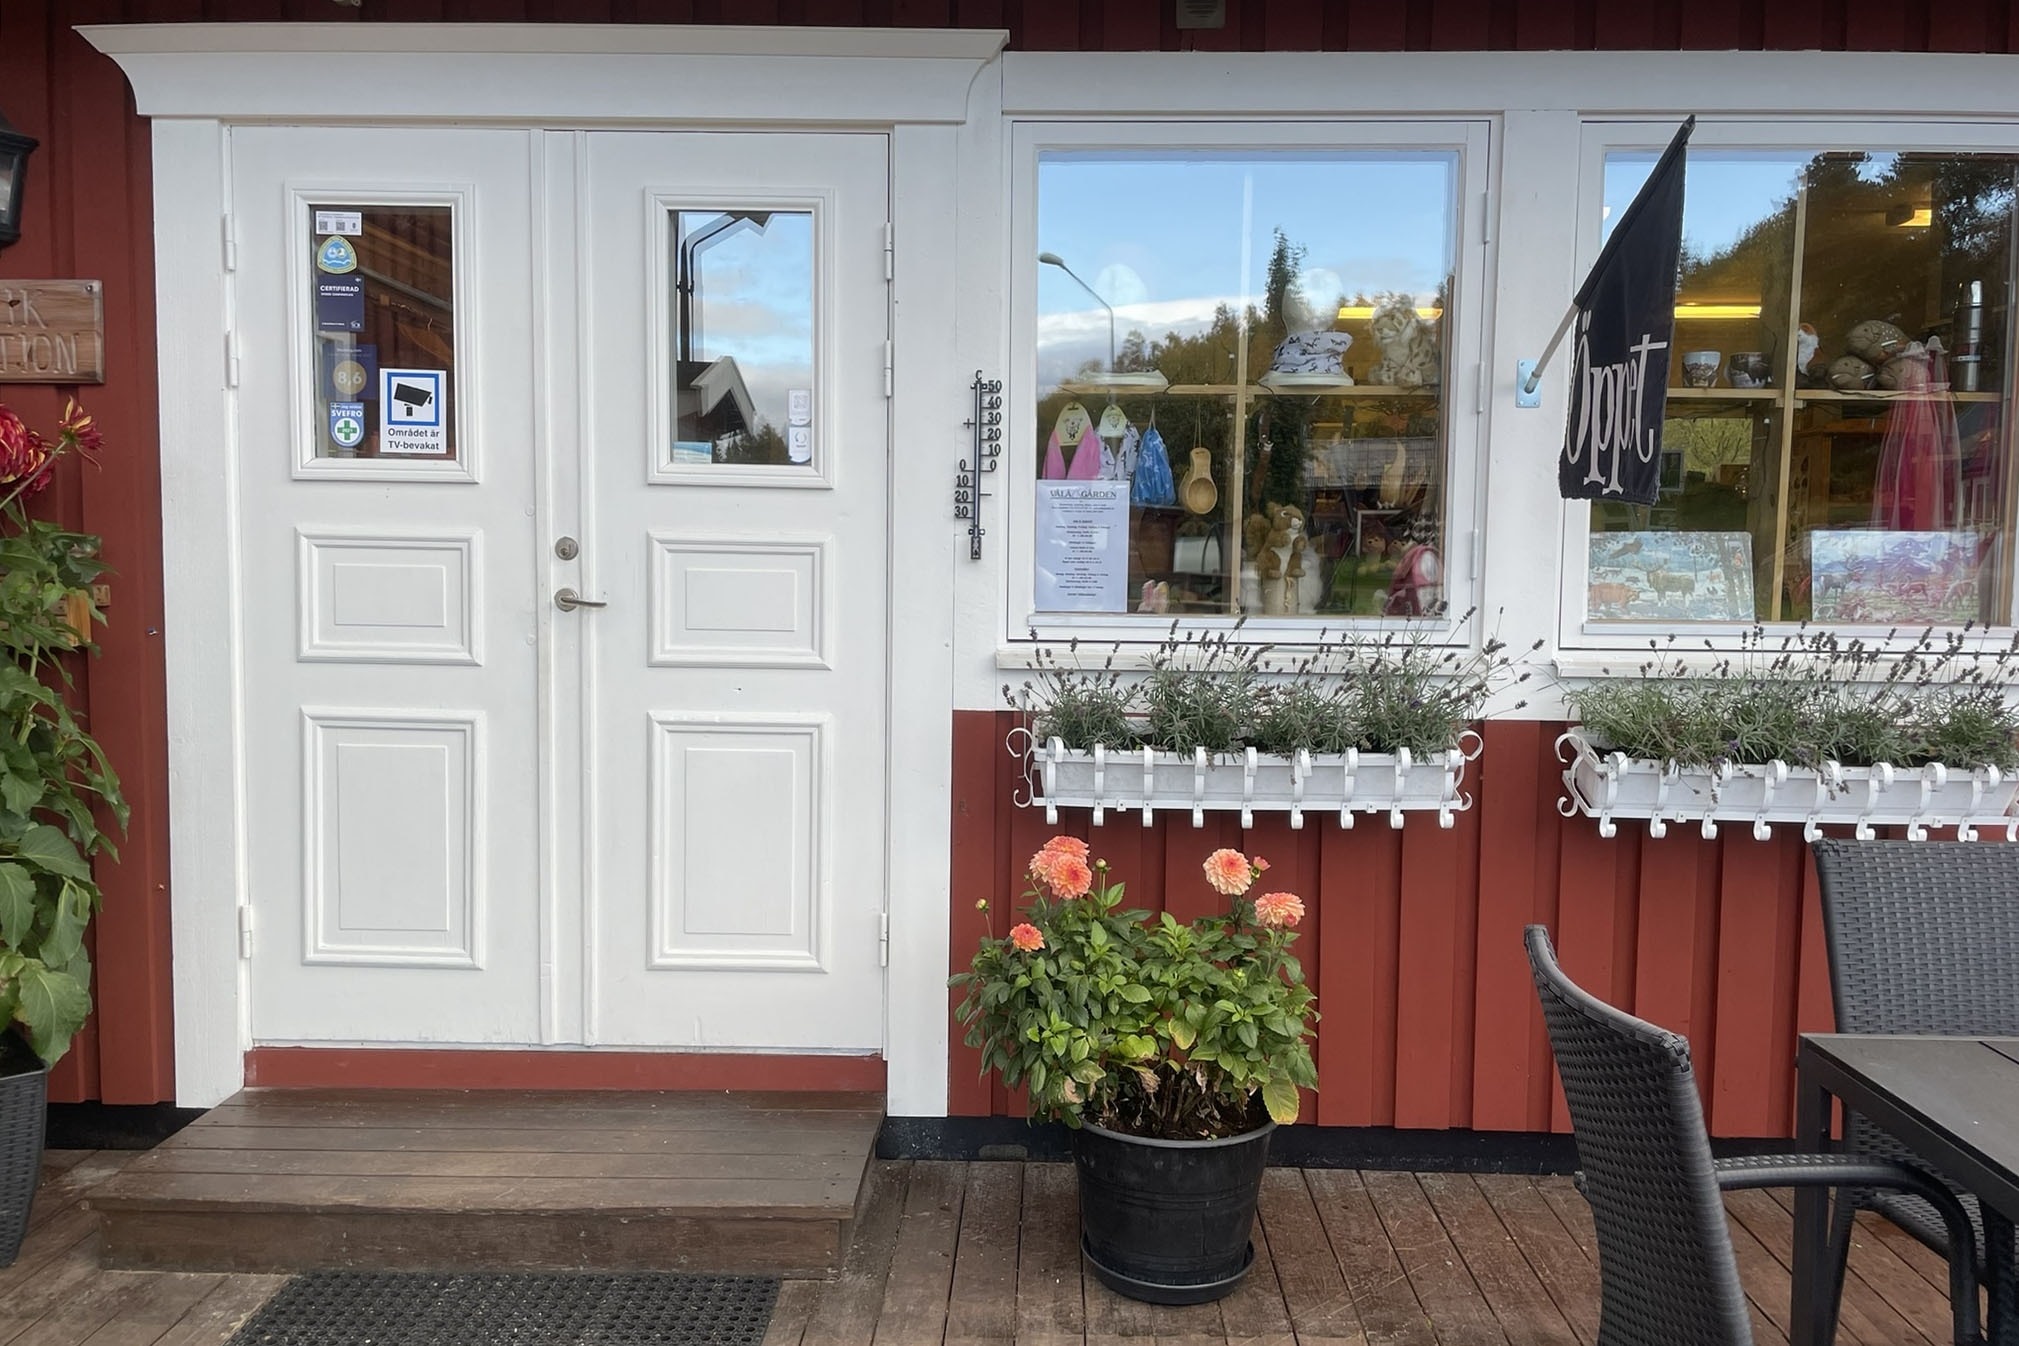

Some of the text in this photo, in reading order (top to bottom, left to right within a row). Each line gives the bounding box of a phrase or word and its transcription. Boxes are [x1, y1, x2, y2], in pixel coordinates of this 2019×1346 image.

[338, 371, 362, 387] 8,6
[987, 380, 1002, 392] 50
[987, 396, 1002, 408] 40
[1566, 309, 1668, 495] Öppet
[987, 412, 1002, 423] 30
[388, 428, 428, 437] Området
[987, 428, 1001, 440] 20
[388, 440, 439, 450] TV-bevakat
[988, 444, 1001, 456] 10
[959, 459, 967, 471] 0
[989, 460, 997, 471] 0
[956, 475, 969, 487] 10
[954, 490, 969, 502] 20
[1080, 488, 1117, 498] GÅRDEN
[954, 506, 969, 518] 30
